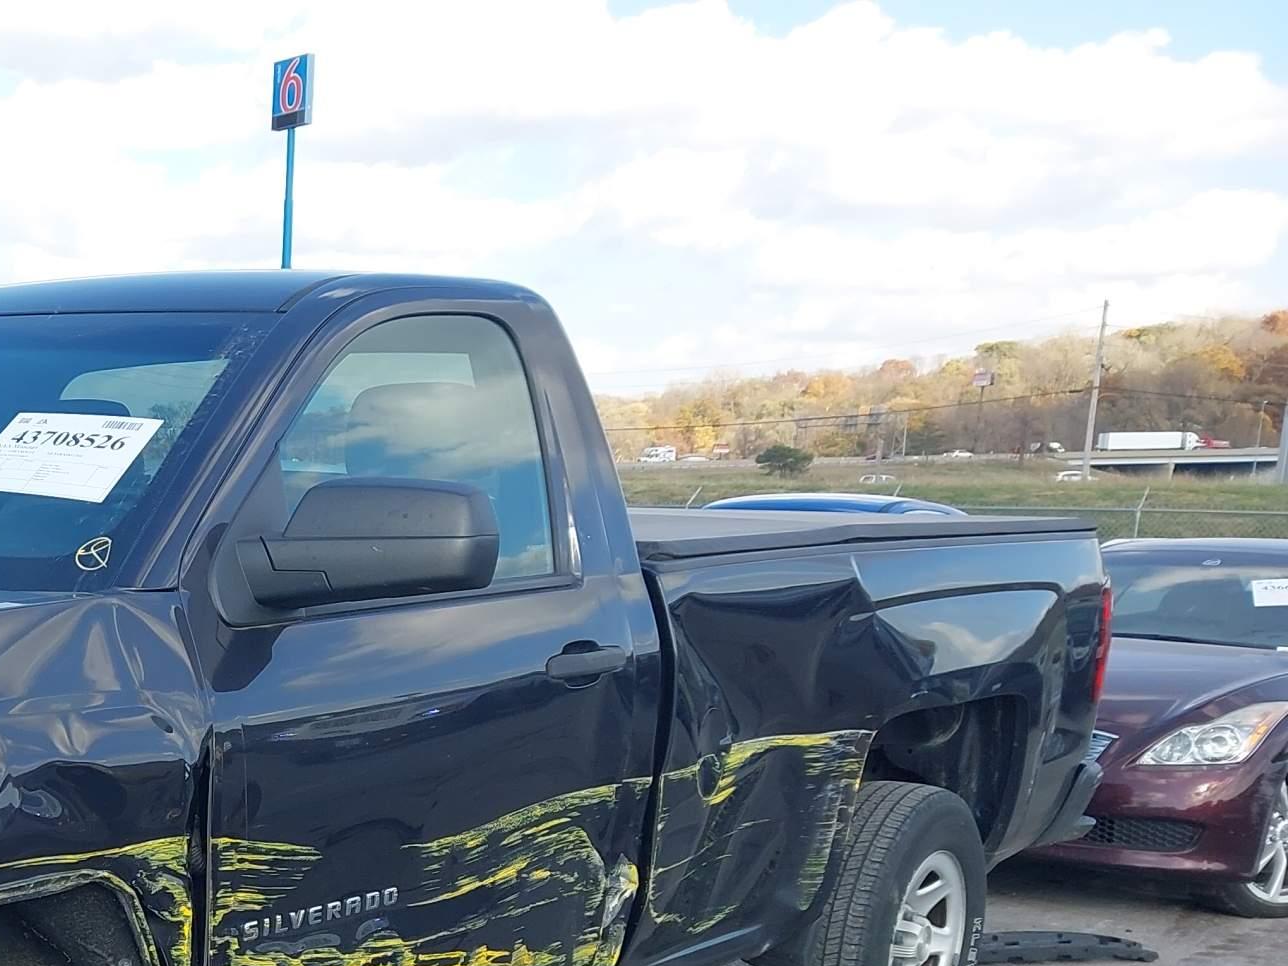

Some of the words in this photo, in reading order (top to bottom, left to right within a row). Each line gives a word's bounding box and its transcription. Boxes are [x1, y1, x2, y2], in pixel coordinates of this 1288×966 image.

[279, 56, 303, 113] 6
[11, 430, 131, 451] 43708526
[242, 887, 400, 942] SILVERADO
